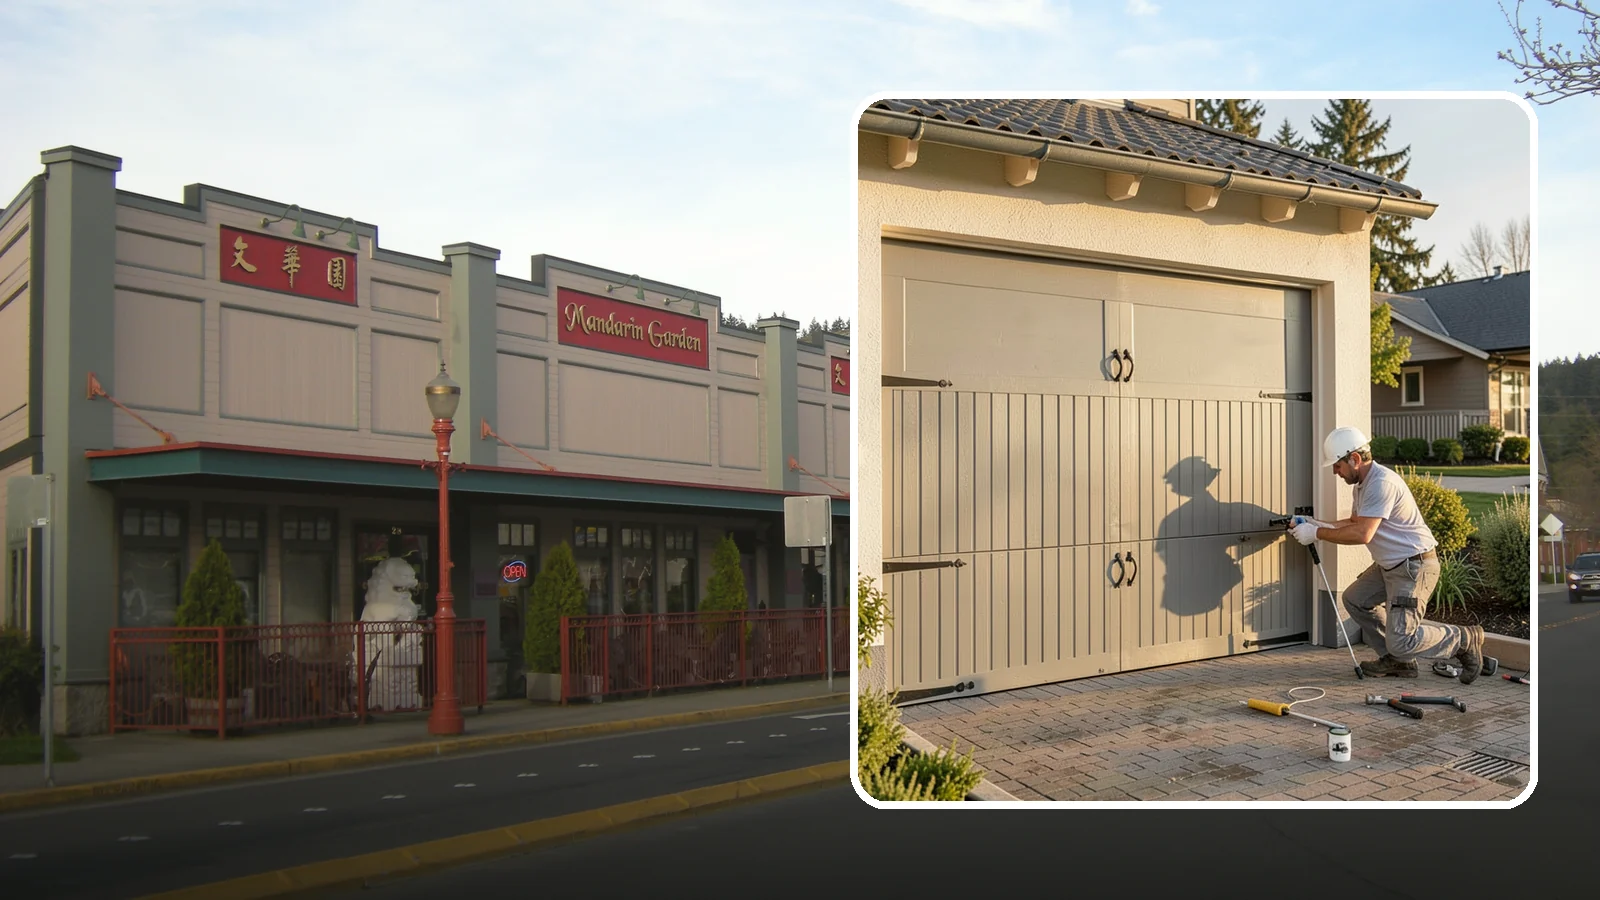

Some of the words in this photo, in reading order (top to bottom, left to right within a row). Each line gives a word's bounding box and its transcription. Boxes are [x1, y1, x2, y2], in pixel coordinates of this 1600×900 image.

[564, 302, 644, 340] Mandarin
[648, 320, 701, 352] Garden
[503, 565, 527, 578] OPEN
